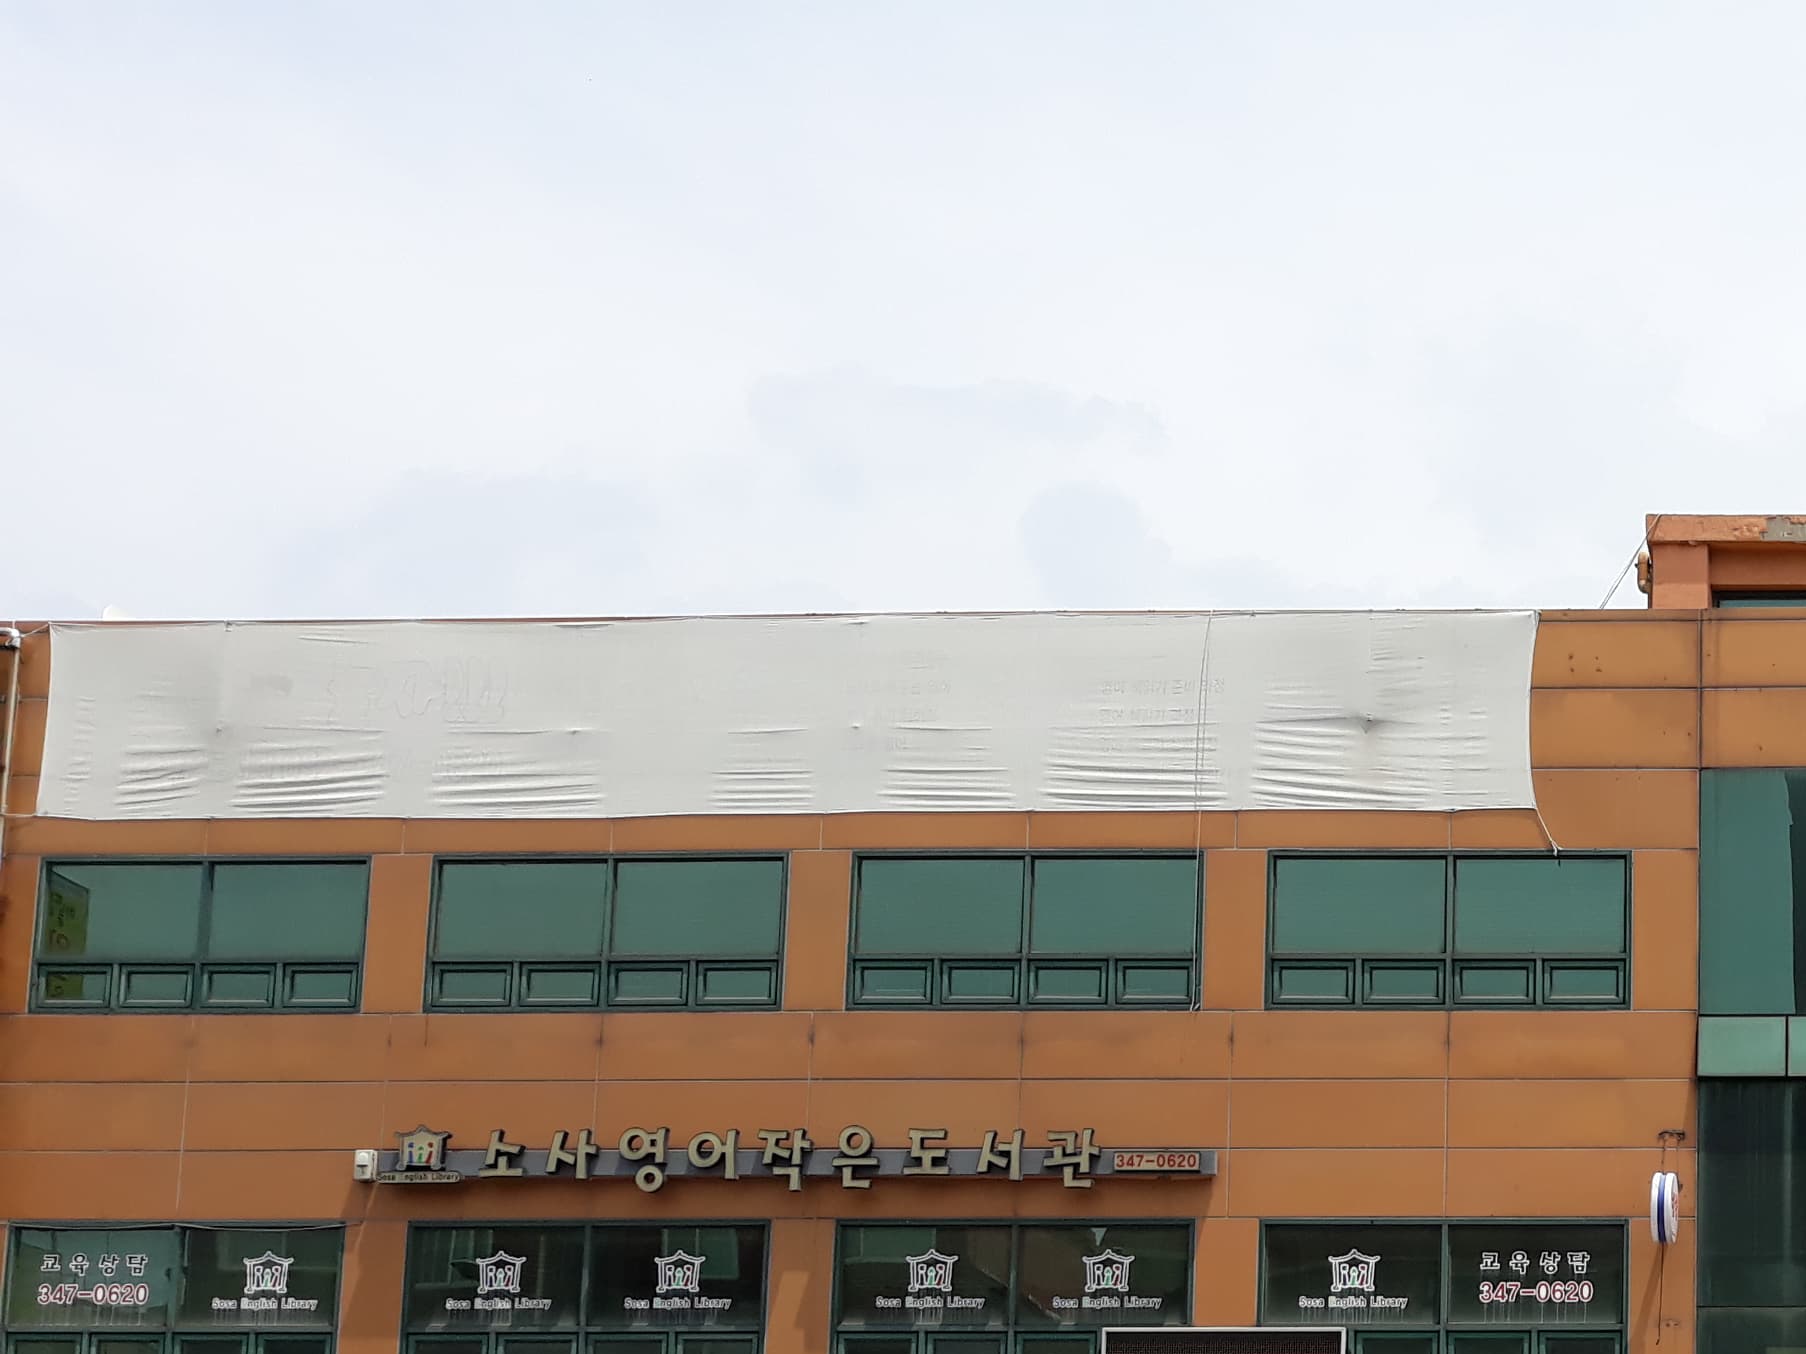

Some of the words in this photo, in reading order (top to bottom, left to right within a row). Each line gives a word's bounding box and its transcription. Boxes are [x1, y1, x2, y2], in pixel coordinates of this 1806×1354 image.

[1116, 1153, 1197, 1169] 347-0620
[399, 1173, 428, 1183] nglish
[38, 1283, 149, 1306] 347-0620
[1479, 1281, 1594, 1303] 347-0620
[212, 1296, 236, 1311] Sosa
[240, 1296, 277, 1311] English
[281, 1296, 318, 1311] Library
[446, 1297, 471, 1311] Sosa
[474, 1297, 511, 1311] English
[515, 1297, 551, 1311] Library
[624, 1297, 649, 1311] Sosa
[653, 1297, 690, 1311] English
[694, 1297, 731, 1311] Library
[876, 1295, 900, 1310] Sosa
[905, 1295, 943, 1310] English
[947, 1295, 985, 1310] Library
[1053, 1295, 1078, 1310] Sosa
[1082, 1295, 1120, 1310] English
[1124, 1295, 1162, 1310] Library
[1299, 1295, 1324, 1310] Sosa
[1328, 1295, 1366, 1310] English
[1370, 1295, 1408, 1310] Library
